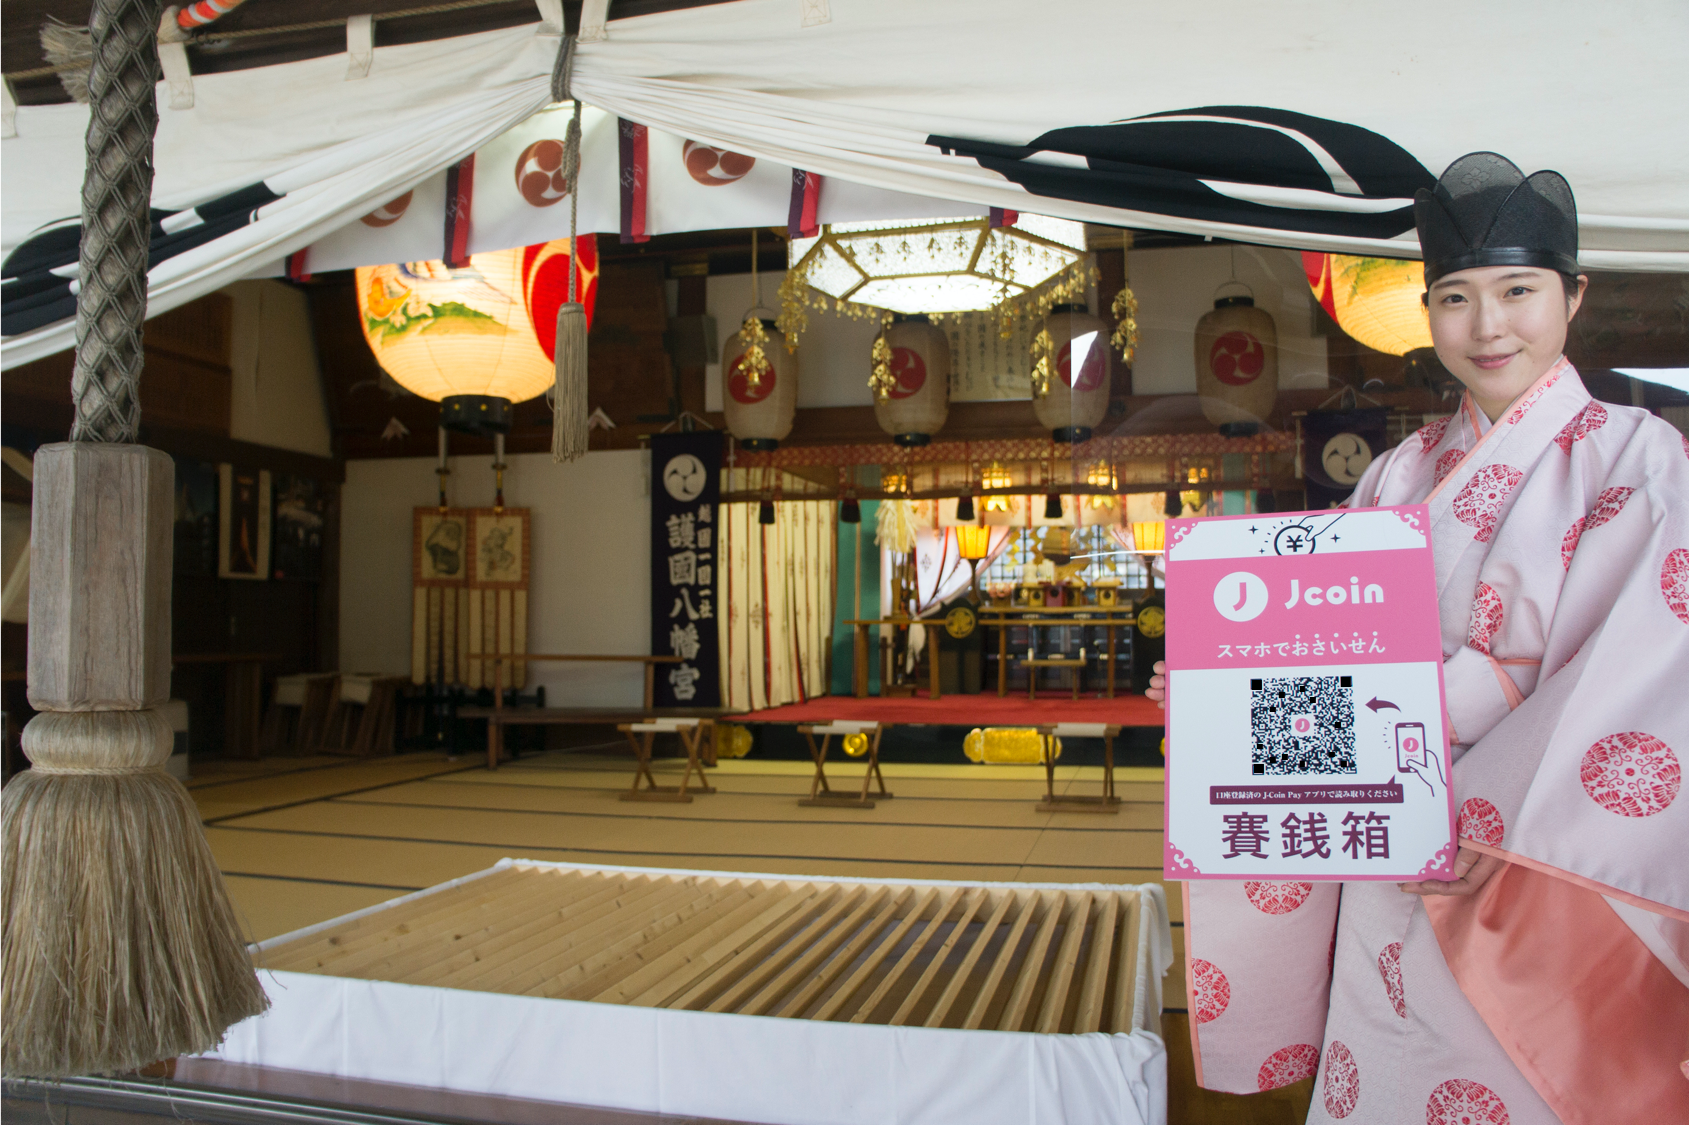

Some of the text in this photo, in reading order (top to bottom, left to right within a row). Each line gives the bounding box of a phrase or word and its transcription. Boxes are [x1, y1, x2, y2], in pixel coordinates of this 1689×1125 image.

[1286, 535, 1303, 552] ¥
[1284, 576, 1384, 610] Jcoin
[1217, 632, 1386, 659] スマホでおさいせん
[1262, 791, 1286, 799] J-Coin
[1287, 791, 1302, 800] Pay
[1304, 789, 1398, 799] アプリで読み取りください
[1221, 810, 1391, 860] 賽銭箱
